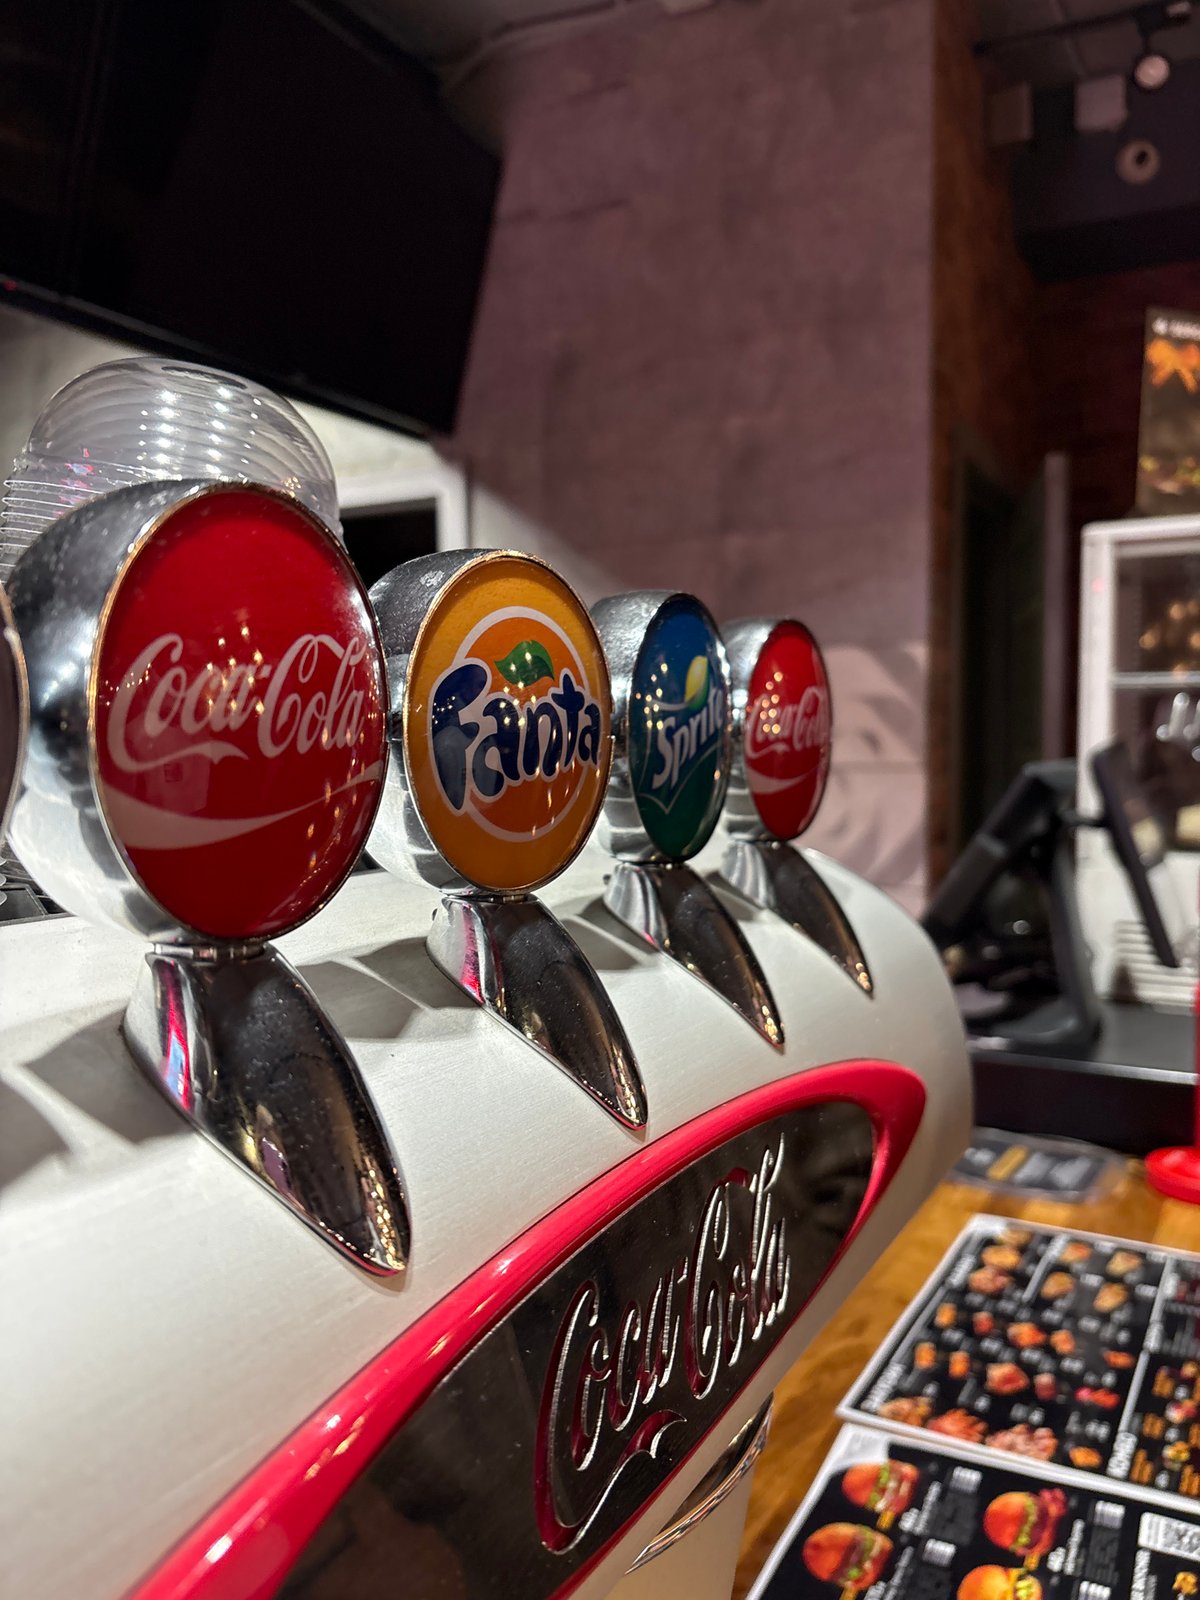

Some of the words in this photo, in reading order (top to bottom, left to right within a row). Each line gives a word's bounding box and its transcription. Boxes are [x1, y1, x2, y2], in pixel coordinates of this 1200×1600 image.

[107, 633, 367, 773] Coca-Cola
[430, 660, 602, 813] Fanta
[534, 1132, 791, 1555] Coca-Cola
